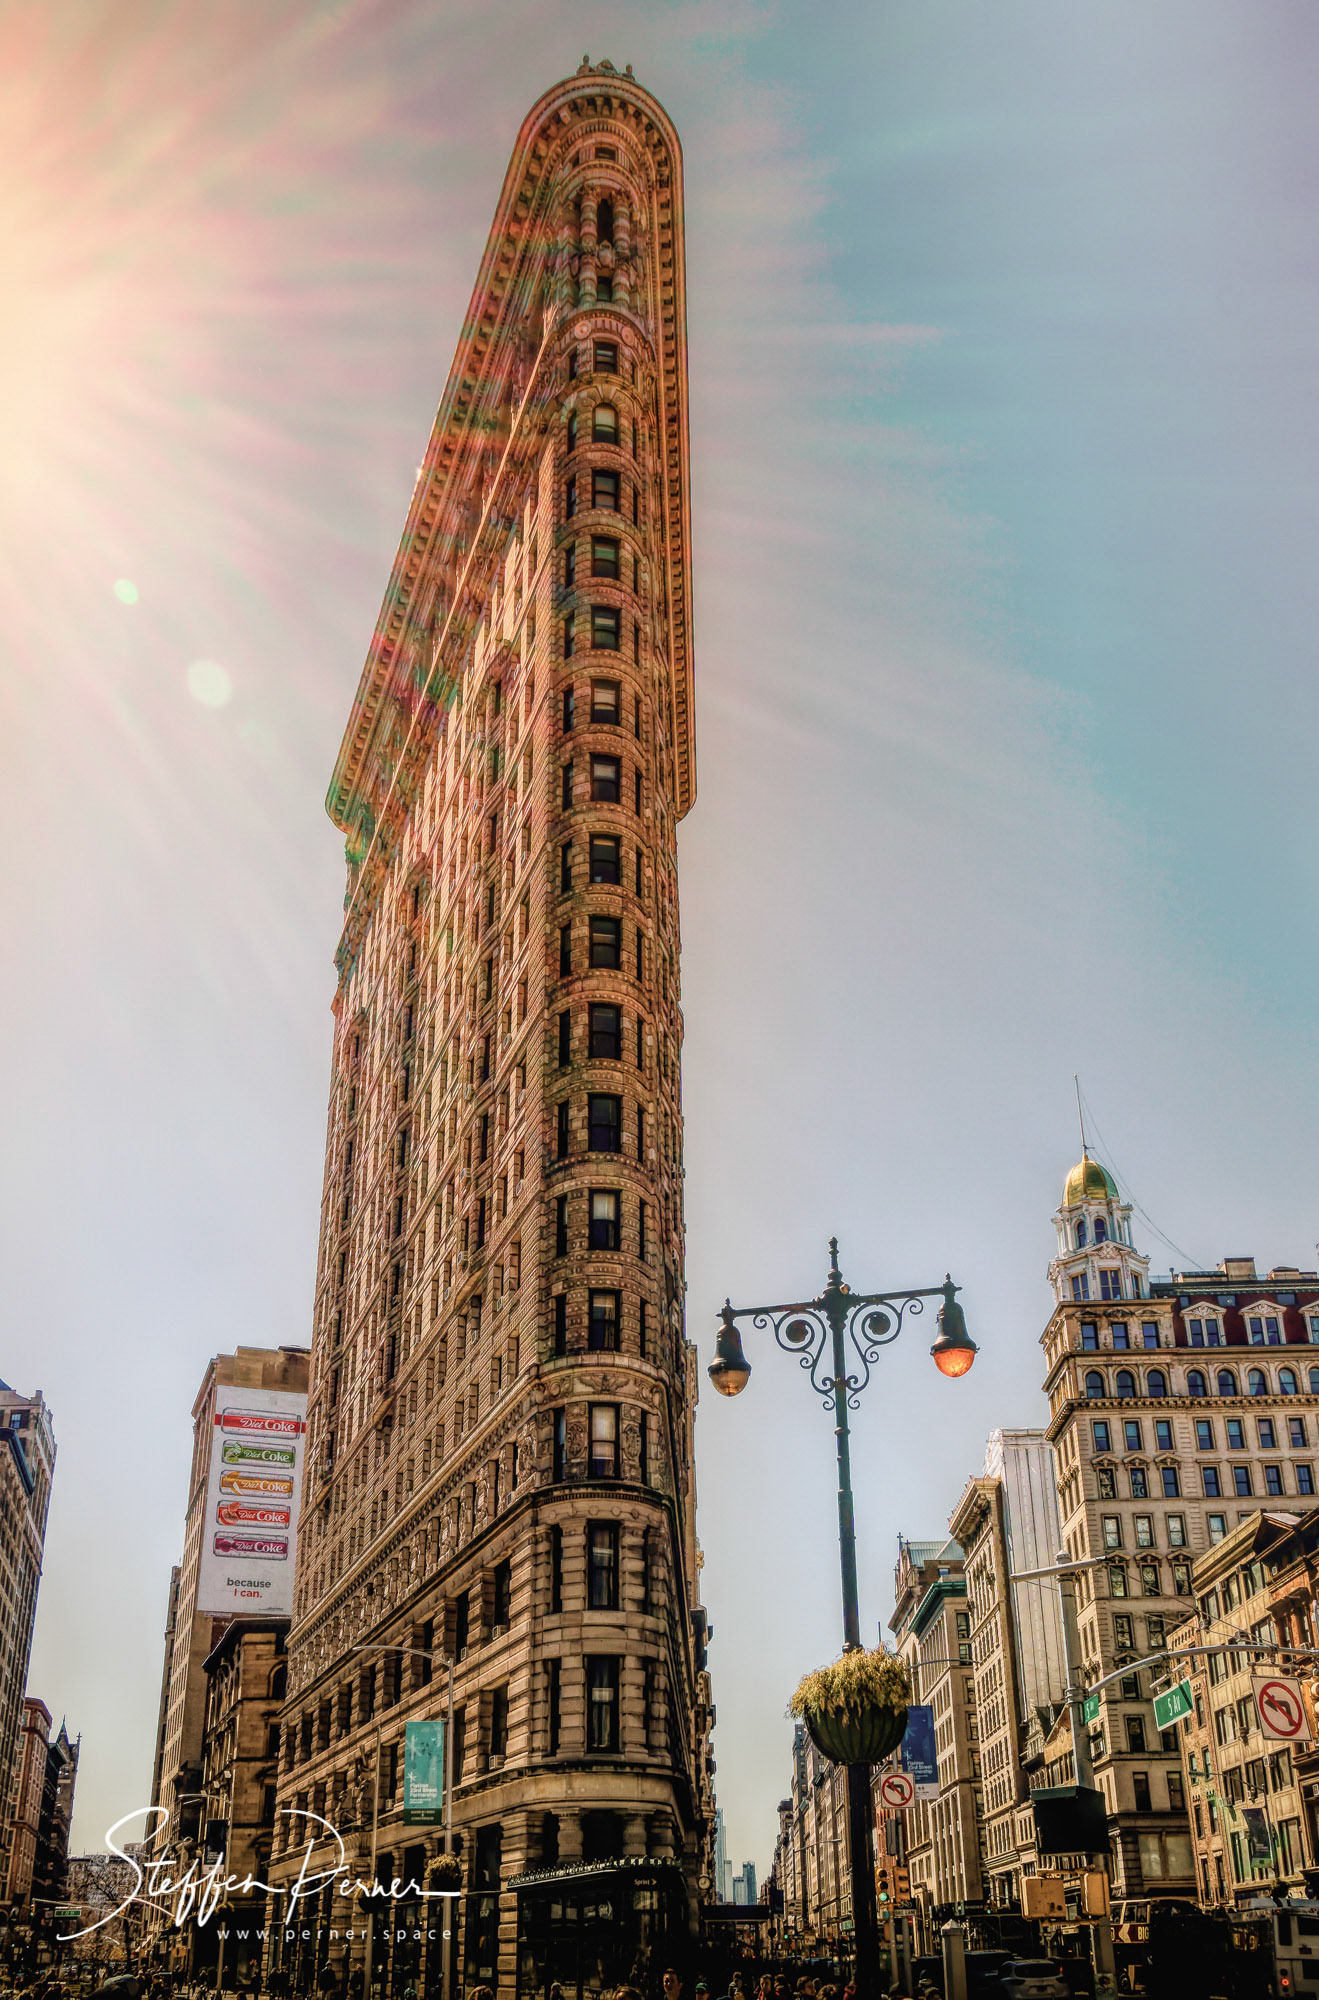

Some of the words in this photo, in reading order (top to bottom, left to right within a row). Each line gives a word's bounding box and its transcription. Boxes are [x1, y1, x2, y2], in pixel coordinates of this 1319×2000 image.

[240, 1417, 264, 1428] Diet
[264, 1419, 295, 1432] Coke
[243, 1449, 261, 1458] Diet
[261, 1450, 290, 1462] Coke
[241, 1480, 259, 1489] Diet
[259, 1480, 288, 1492] Coke
[238, 1510, 256, 1519] Diet
[256, 1510, 285, 1522] Coke
[236, 1541, 254, 1550] Diet
[254, 1541, 283, 1553] Coke
[227, 1577, 272, 1589] because
[234, 1588, 237, 1597] I
[240, 1590, 263, 1598] can.
[1167, 1697, 1173, 1717] 5
[633, 1878, 650, 1887] Sprint
[1137, 1926, 1150, 1941] BIG
